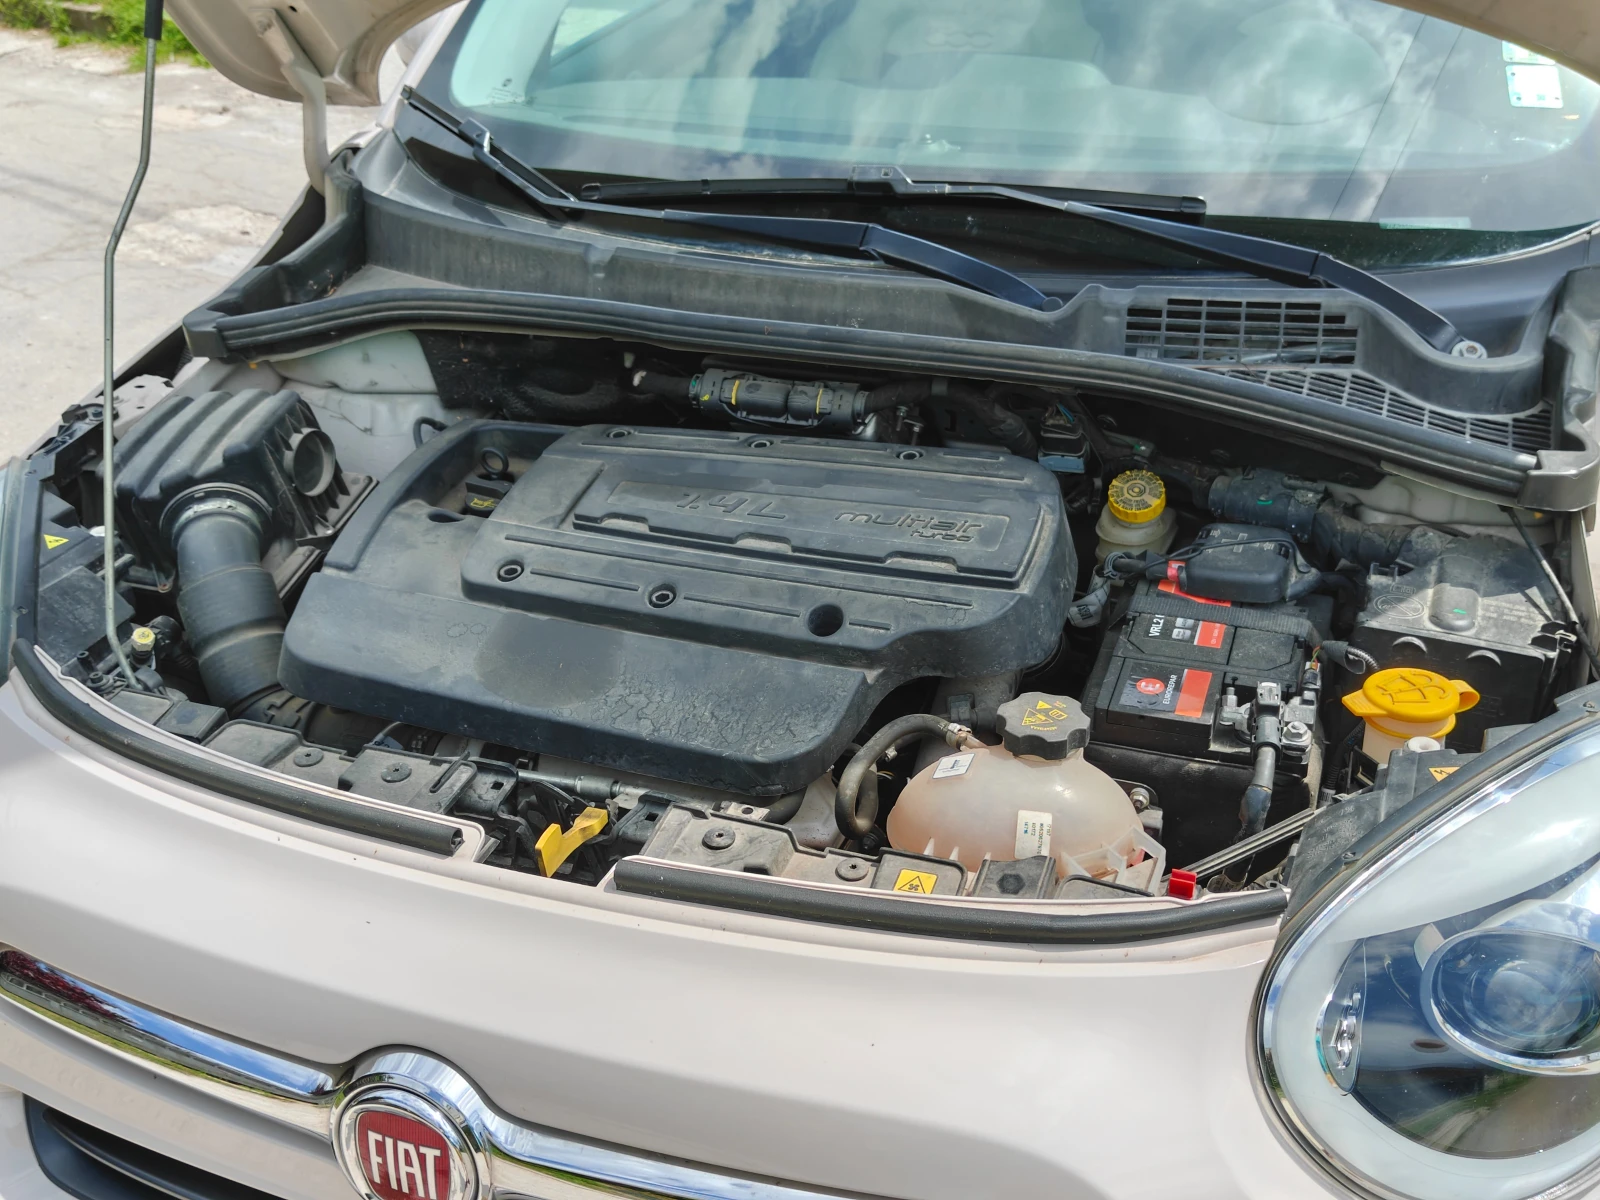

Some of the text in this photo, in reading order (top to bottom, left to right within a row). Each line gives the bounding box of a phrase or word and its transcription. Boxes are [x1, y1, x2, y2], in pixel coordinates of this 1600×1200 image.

[676, 493, 786, 519] 1.4L
[834, 511, 982, 533] multiair
[910, 528, 974, 542] turbo
[1162, 674, 1178, 705] EUROREPAR
[367, 1129, 441, 1200] FIAT
